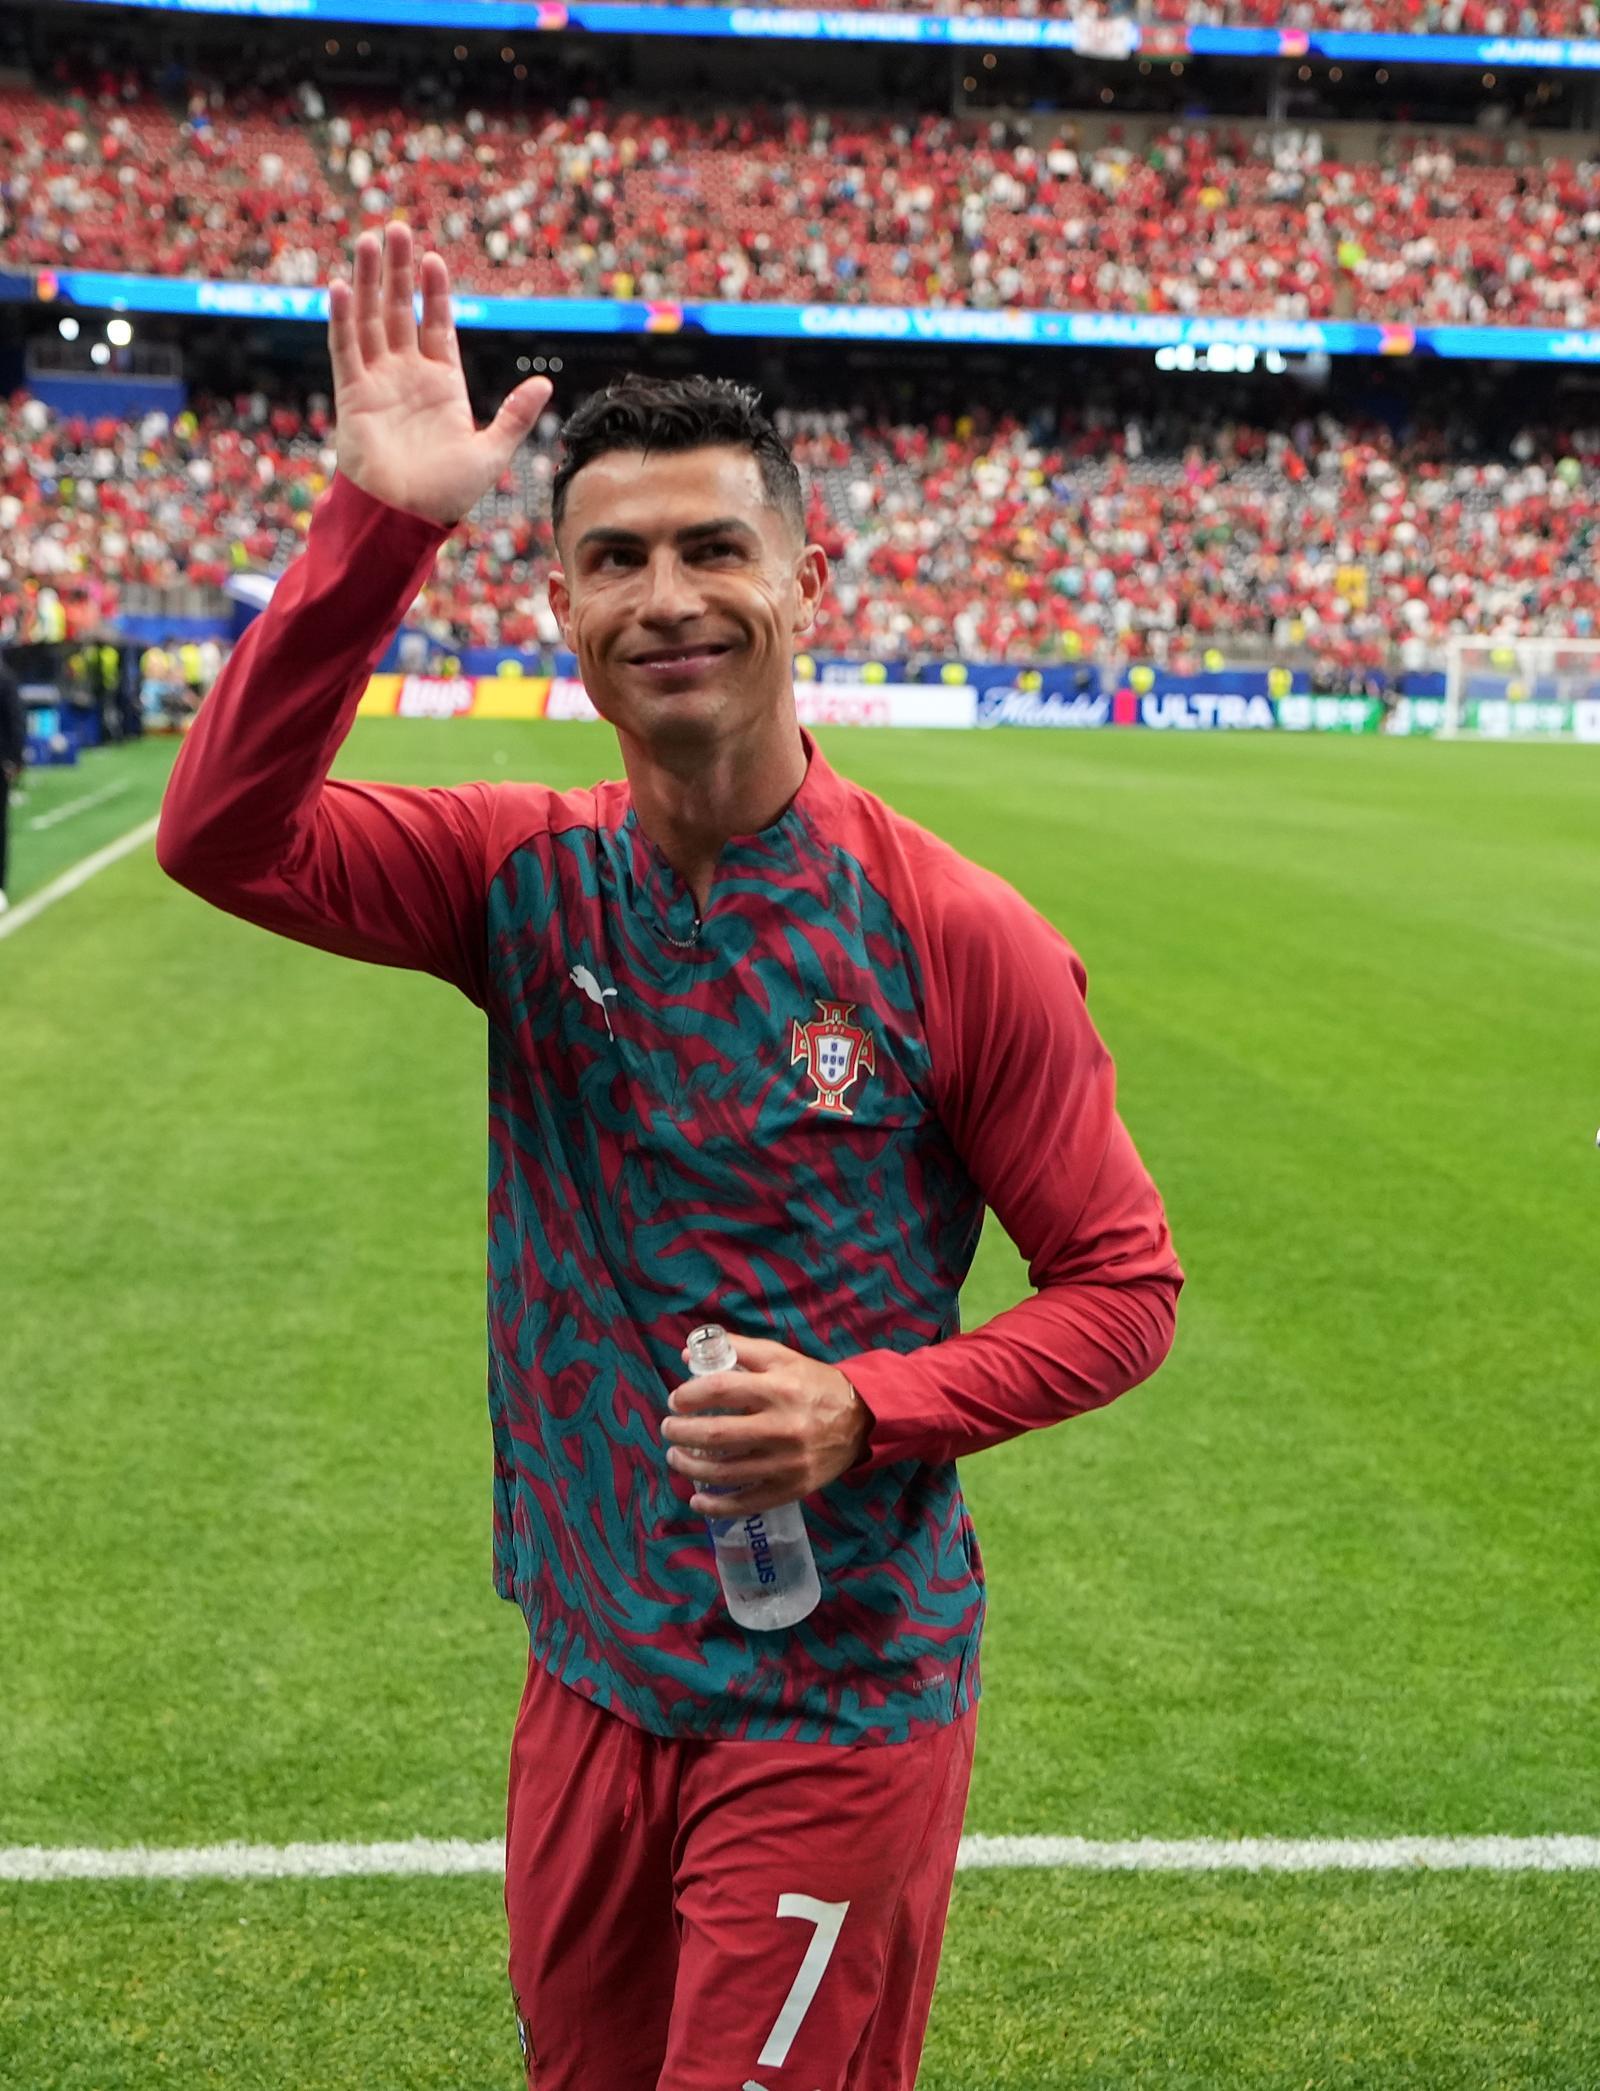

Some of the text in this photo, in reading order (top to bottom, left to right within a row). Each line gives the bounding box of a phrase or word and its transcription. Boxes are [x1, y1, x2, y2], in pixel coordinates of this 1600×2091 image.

[1142, 693, 1275, 729] ULTRA
[744, 1513, 776, 1584] smart
[757, 1893, 850, 2068] 7
